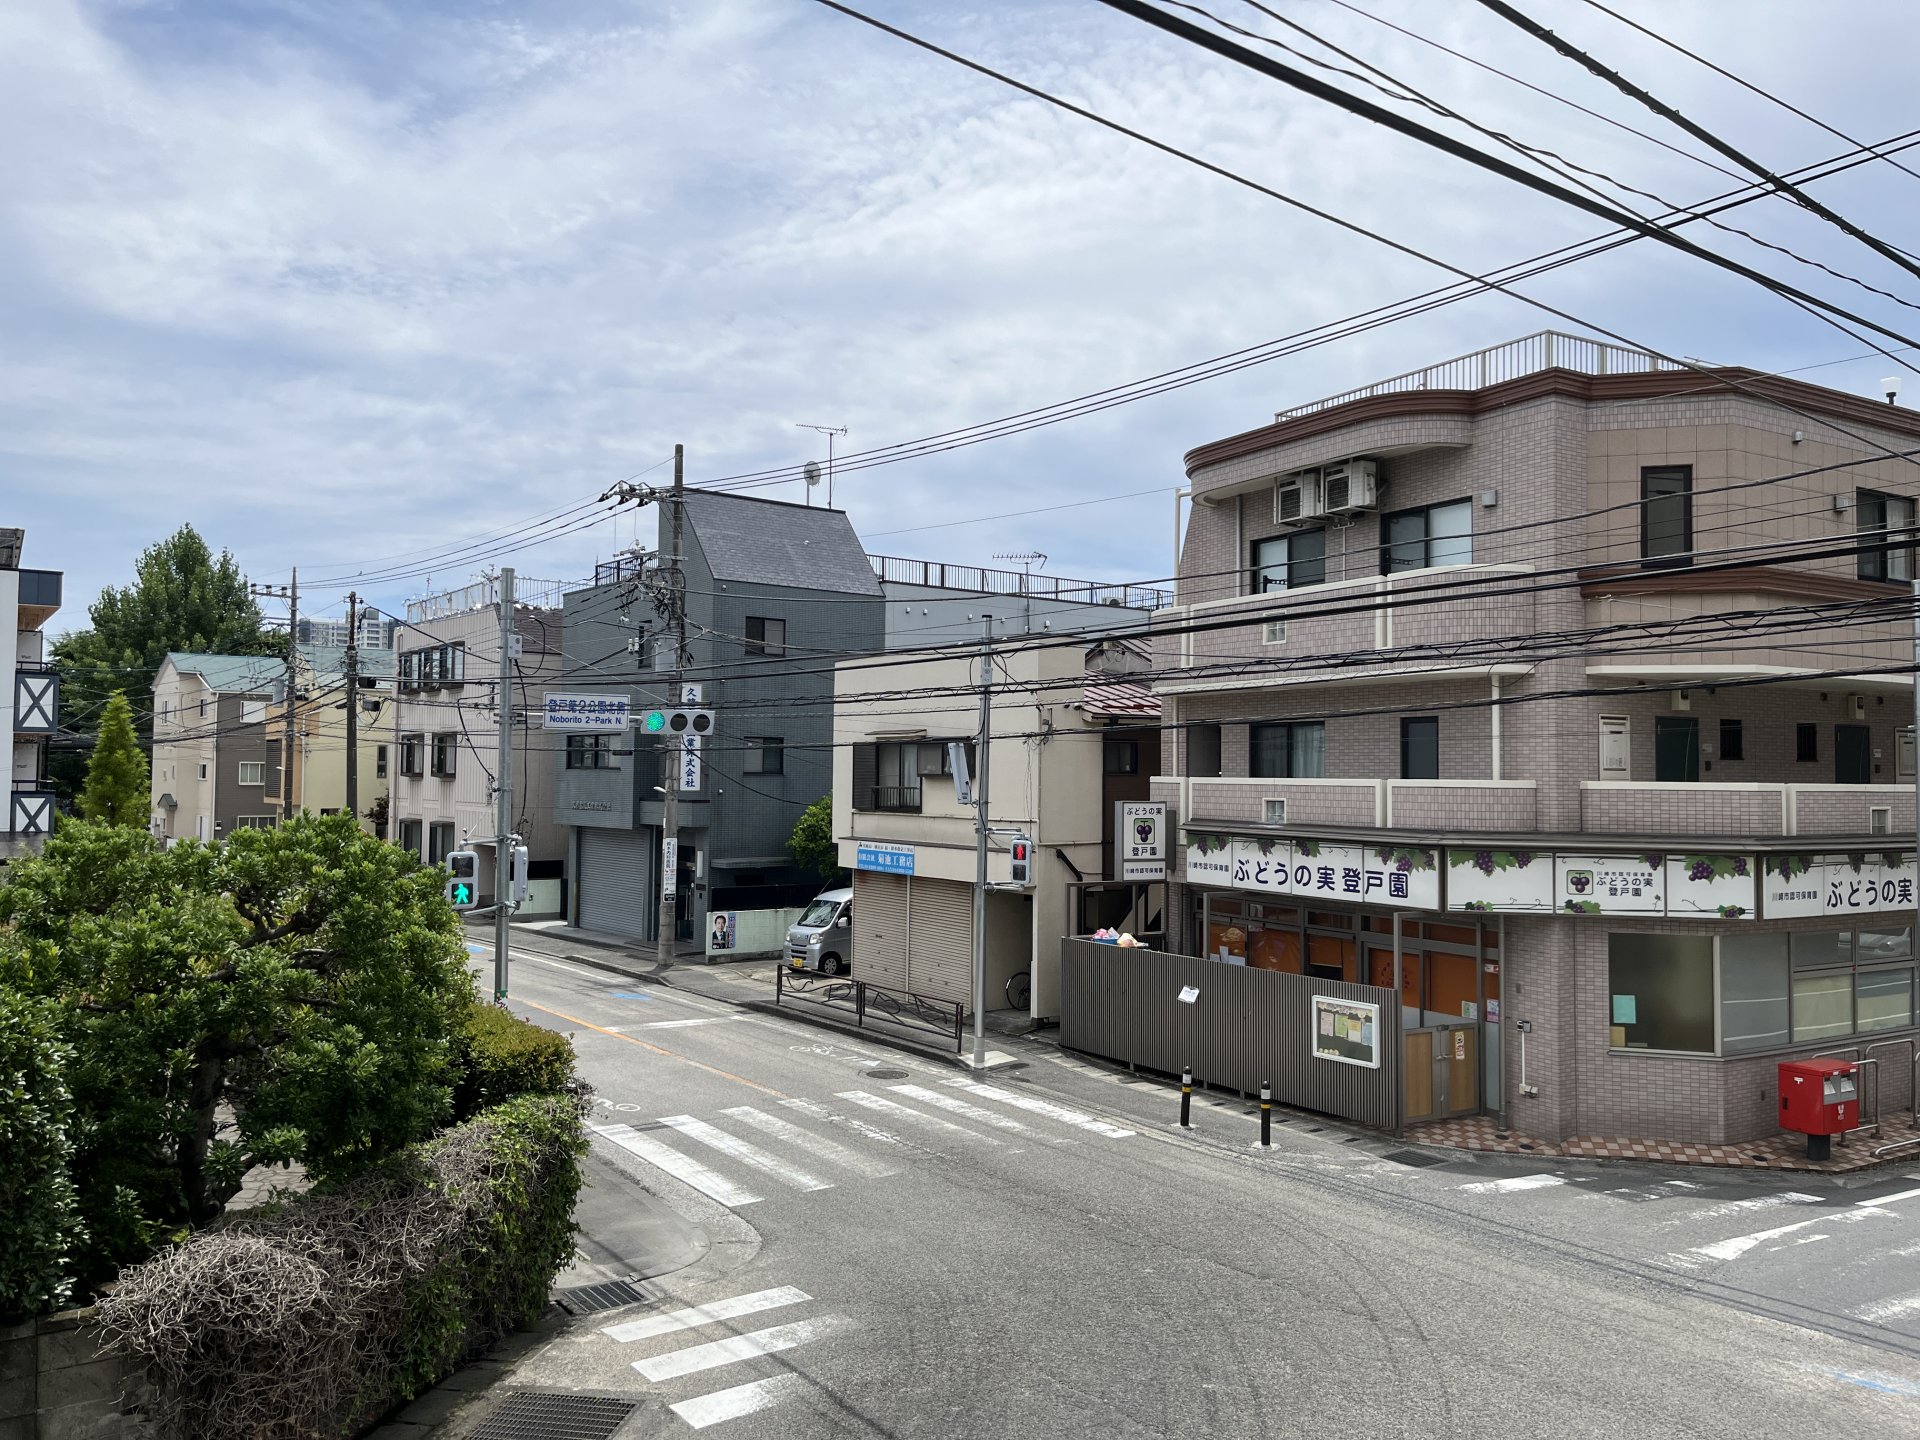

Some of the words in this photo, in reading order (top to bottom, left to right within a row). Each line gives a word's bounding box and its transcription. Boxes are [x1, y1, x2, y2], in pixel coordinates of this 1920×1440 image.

[550, 715, 582, 724] Noborito
[585, 716, 612, 725] 2-Park
[615, 717, 623, 725] N.
[1126, 807, 1163, 816] ぶどうの実
[1132, 846, 1158, 857] 登戸園
[1188, 861, 1230, 873] 川崎市認可保育園
[1234, 858, 1409, 899] ぶどうの実登戸園
[1596, 877, 1654, 888] ぶどうの実
[1608, 887, 1642, 897] 登戸園
[1772, 890, 1818, 902] 川崎市認可保育園
[1826, 877, 1913, 908] ぶどうの実
